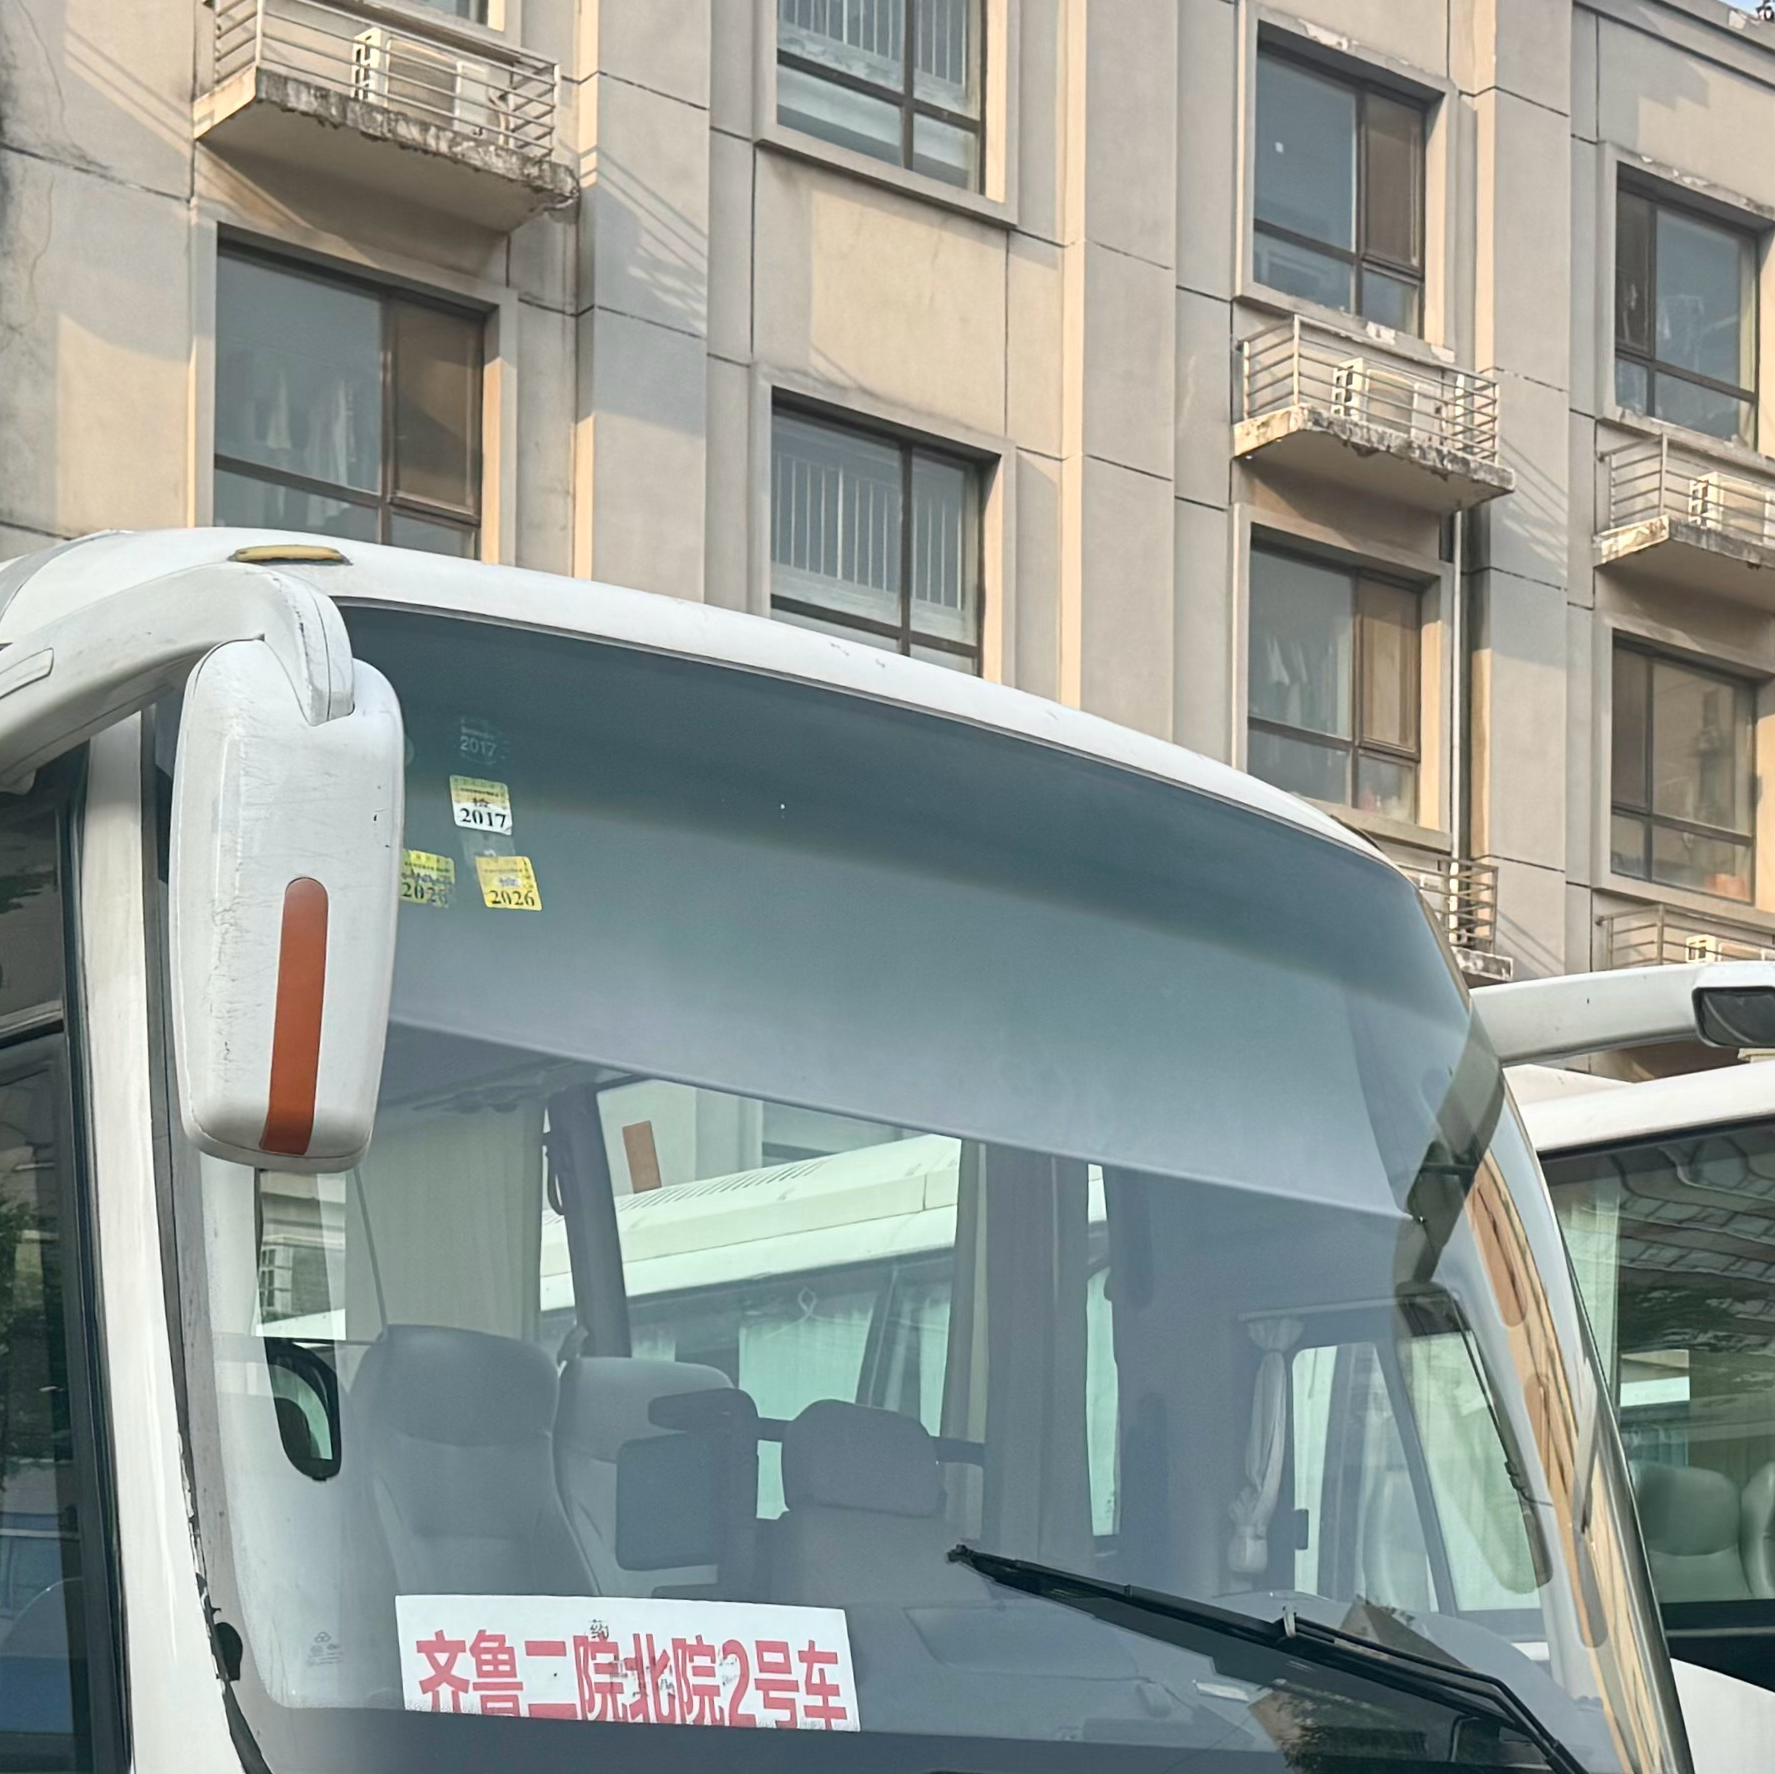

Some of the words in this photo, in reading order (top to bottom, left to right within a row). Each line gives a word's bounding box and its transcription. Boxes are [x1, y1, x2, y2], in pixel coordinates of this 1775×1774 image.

[460, 736, 497, 757] 2017
[460, 808, 506, 829] 2017
[489, 889, 535, 907] 2026
[415, 1629, 848, 1731] 齐鲁二院北院2号车
